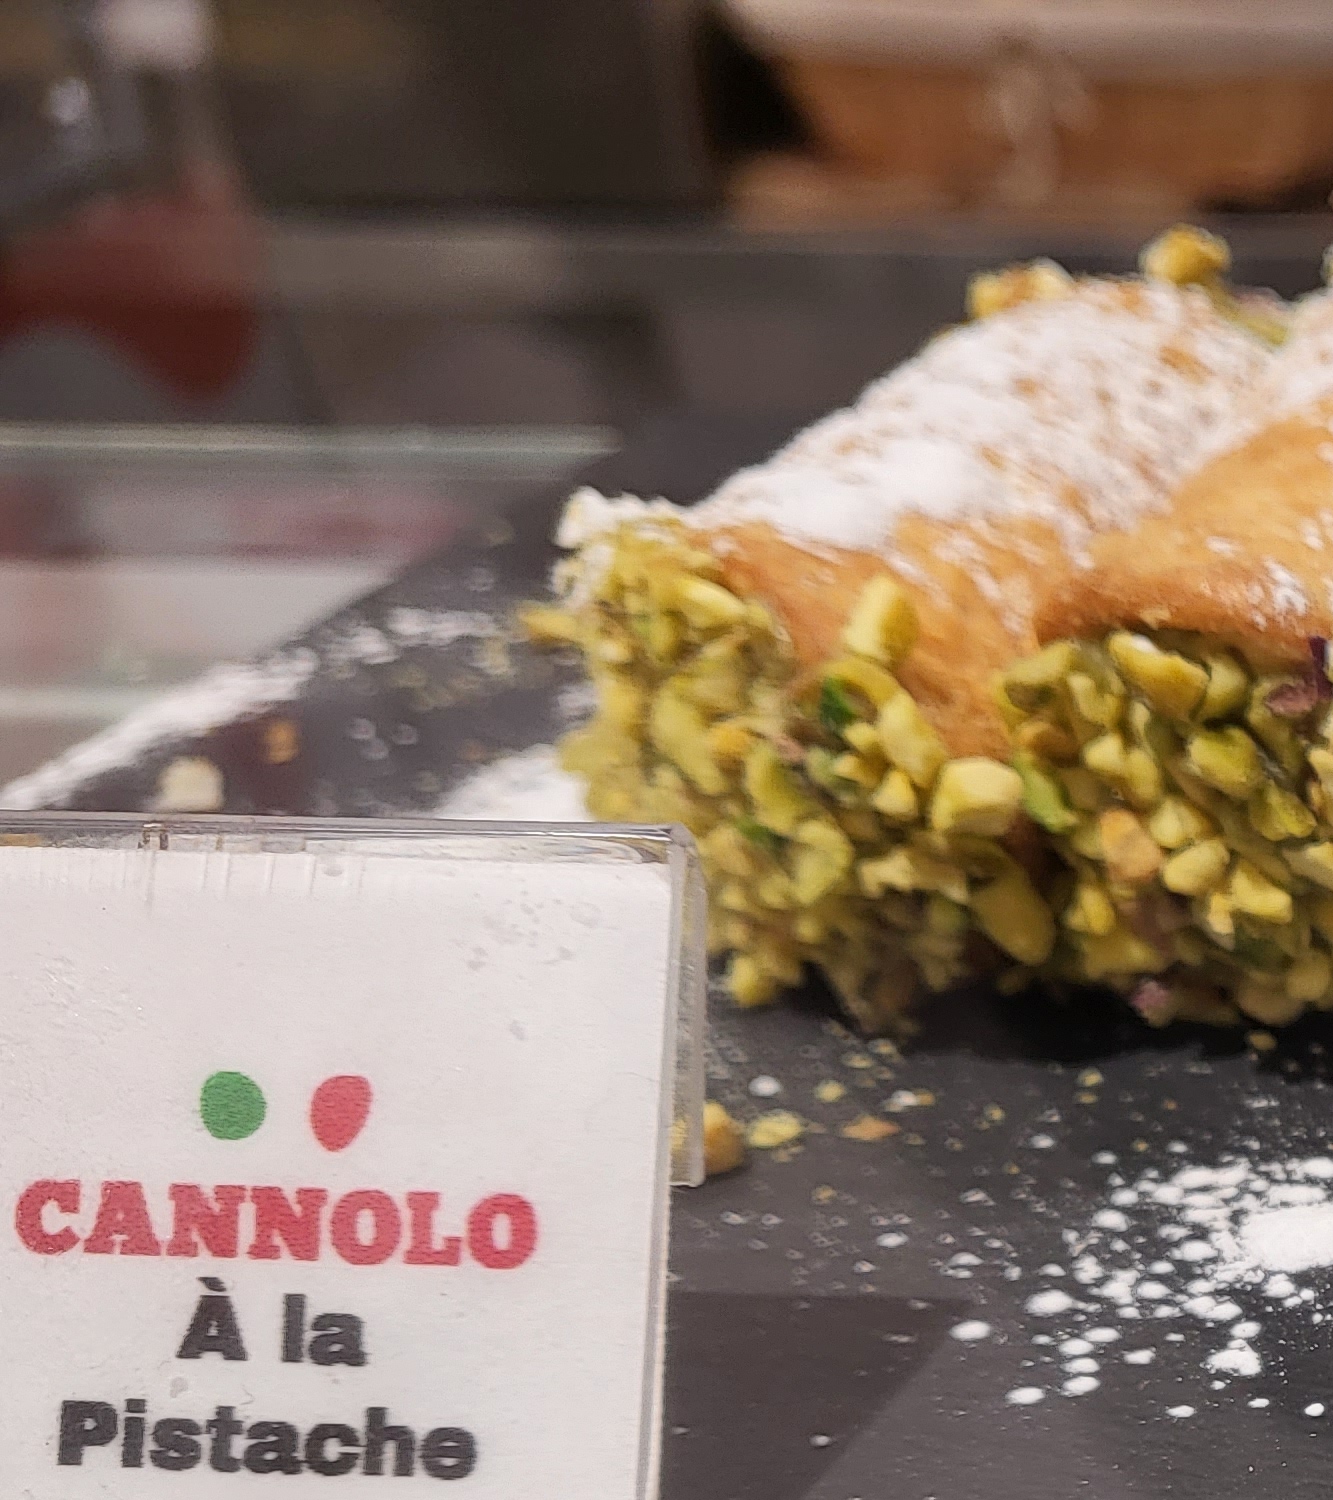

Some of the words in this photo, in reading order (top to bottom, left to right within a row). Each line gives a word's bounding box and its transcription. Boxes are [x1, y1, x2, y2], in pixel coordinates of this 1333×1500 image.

[15, 1179, 539, 1270] CANNOLO
[177, 1277, 247, 1361] À
[282, 1294, 368, 1366] la
[58, 1399, 476, 1480] Pistache
